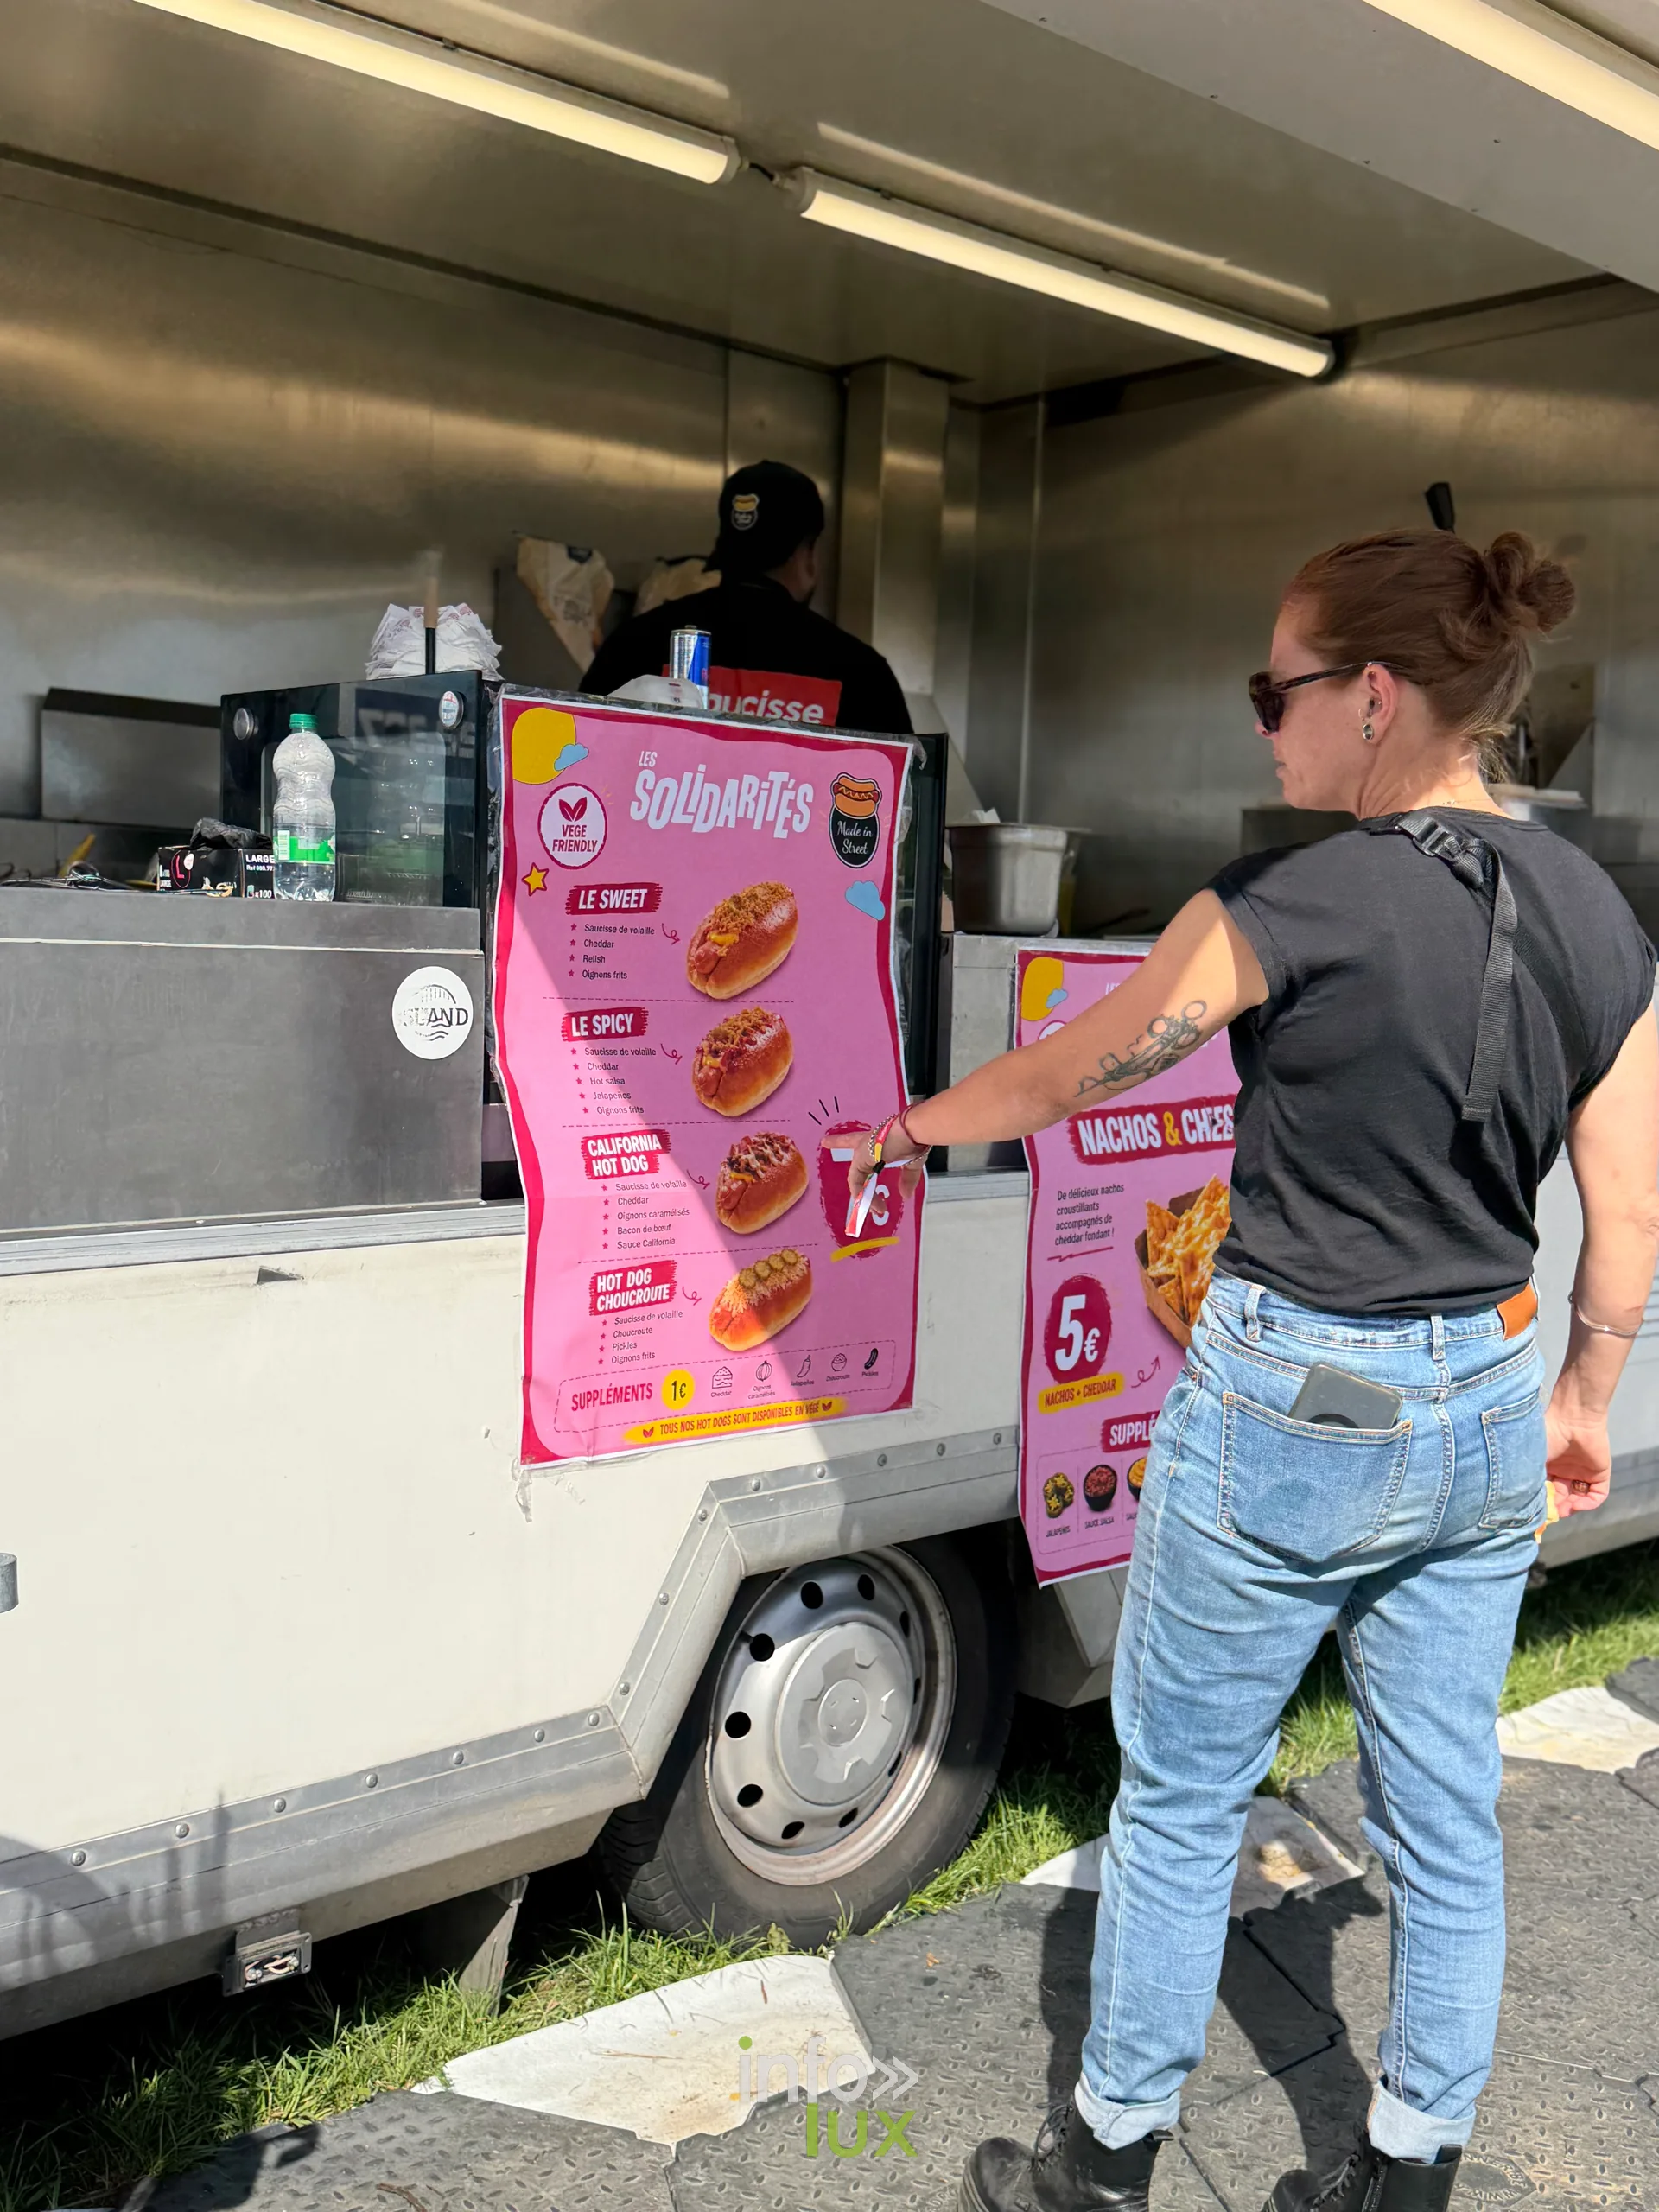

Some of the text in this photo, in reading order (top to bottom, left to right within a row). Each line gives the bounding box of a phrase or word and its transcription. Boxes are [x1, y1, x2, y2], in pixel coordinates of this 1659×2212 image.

[639, 751, 658, 767] LES
[562, 825, 587, 837] VEGE
[837, 821, 873, 837] Made in
[552, 839, 598, 853] FRIENDLY
[842, 838, 868, 855] Street
[245, 854, 276, 863] LARGE
[578, 888, 648, 910] LE SWEET
[584, 923, 655, 935] Saucisse de volaille
[583, 938, 614, 948] Cheddar
[582, 954, 606, 963] Relish
[582, 969, 627, 980] Oignons frits
[571, 1013, 634, 1037] LE SPICY
[584, 1047, 656, 1056] Saucisse de volaille
[587, 1062, 619, 1071] Cheddar
[605, 1077, 626, 1085] salsa
[594, 1091, 632, 1101] Jalapeños
[596, 1106, 627, 1116] Oignons
[1077, 1112, 1162, 1156] NACHOS
[1163, 1111, 1183, 1147] &
[588, 1134, 662, 1157] CALIFORNIA
[592, 1154, 649, 1177] HOT DOG
[615, 1180, 687, 1192] Saucisse de volaille
[1057, 1184, 1125, 1201] De délicieux nachos
[618, 1197, 649, 1205] Cheddar
[617, 1207, 690, 1222] Oignons caramélisés
[1056, 1202, 1100, 1216] croustillants
[1055, 1213, 1113, 1231] accompagnés de
[617, 1226, 641, 1235] Bacon
[642, 1224, 652, 1233] de
[1054, 1233, 1084, 1246] cheddar
[1084, 1227, 1111, 1242] fondant
[617, 1236, 676, 1249] Sauce California
[597, 1268, 652, 1293] HOT DOG
[596, 1283, 671, 1312] CHOUCROUTE
[614, 1309, 683, 1325] Saucisse de volaille
[613, 1326, 653, 1338] Choucroute
[1054, 1294, 1101, 1372] 5€
[612, 1341, 638, 1351] Pickles
[611, 1351, 656, 1365] Oignons frits
[571, 1380, 686, 1412] SUPPLÉMENTS 1€
[1045, 1387, 1075, 1408] NACHOS
[1083, 1378, 1116, 1398] CHEDDAR
[660, 1421, 678, 1435] TOUS
[680, 1420, 695, 1433] NOS
[696, 1418, 711, 1430] HOT
[713, 1415, 731, 1427] DOGS
[733, 1411, 751, 1425] SONT
[753, 1405, 792, 1422] DISPONIBLES
[794, 1405, 804, 1415] EN
